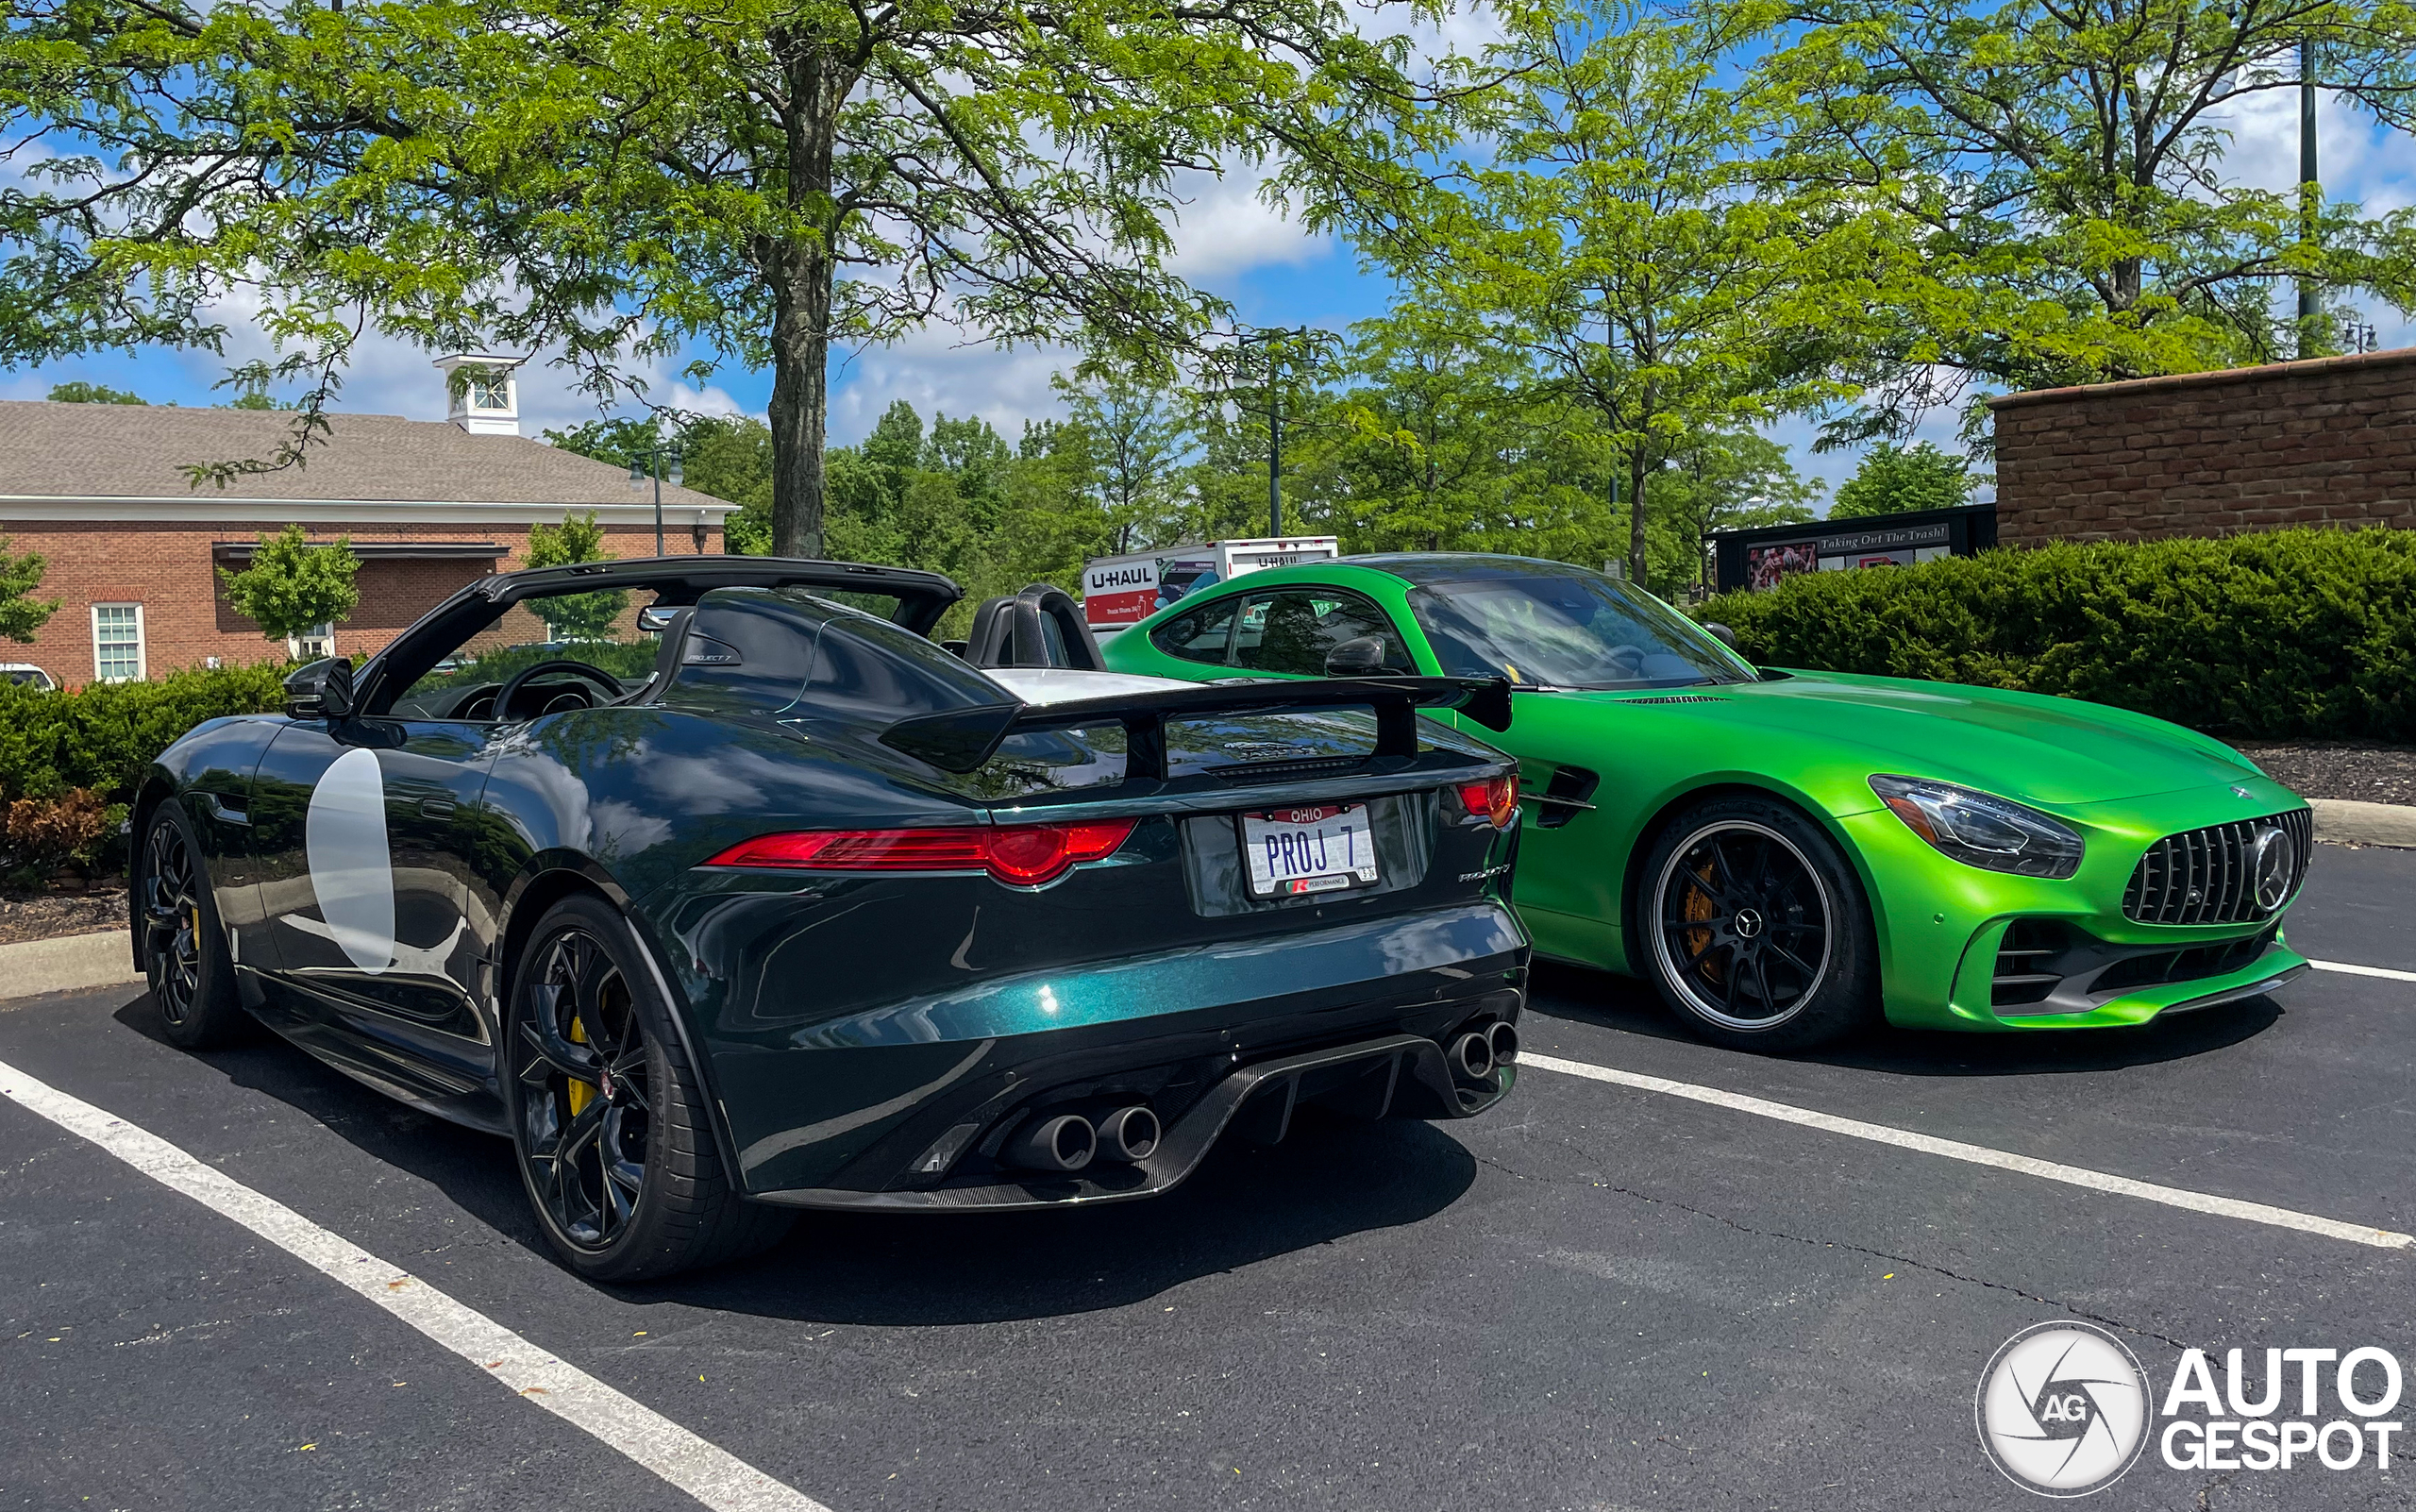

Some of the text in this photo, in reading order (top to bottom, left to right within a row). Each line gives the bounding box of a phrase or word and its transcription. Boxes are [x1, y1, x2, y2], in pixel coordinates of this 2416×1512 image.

[1821, 527, 1945, 548] Taking Out The Trash!
[1092, 567, 1152, 589] U-HAUL
[1291, 808, 1323, 823] OHIO
[1266, 826, 1353, 877] PROJ 7
[1292, 877, 1345, 894] R PERFORMANCE
